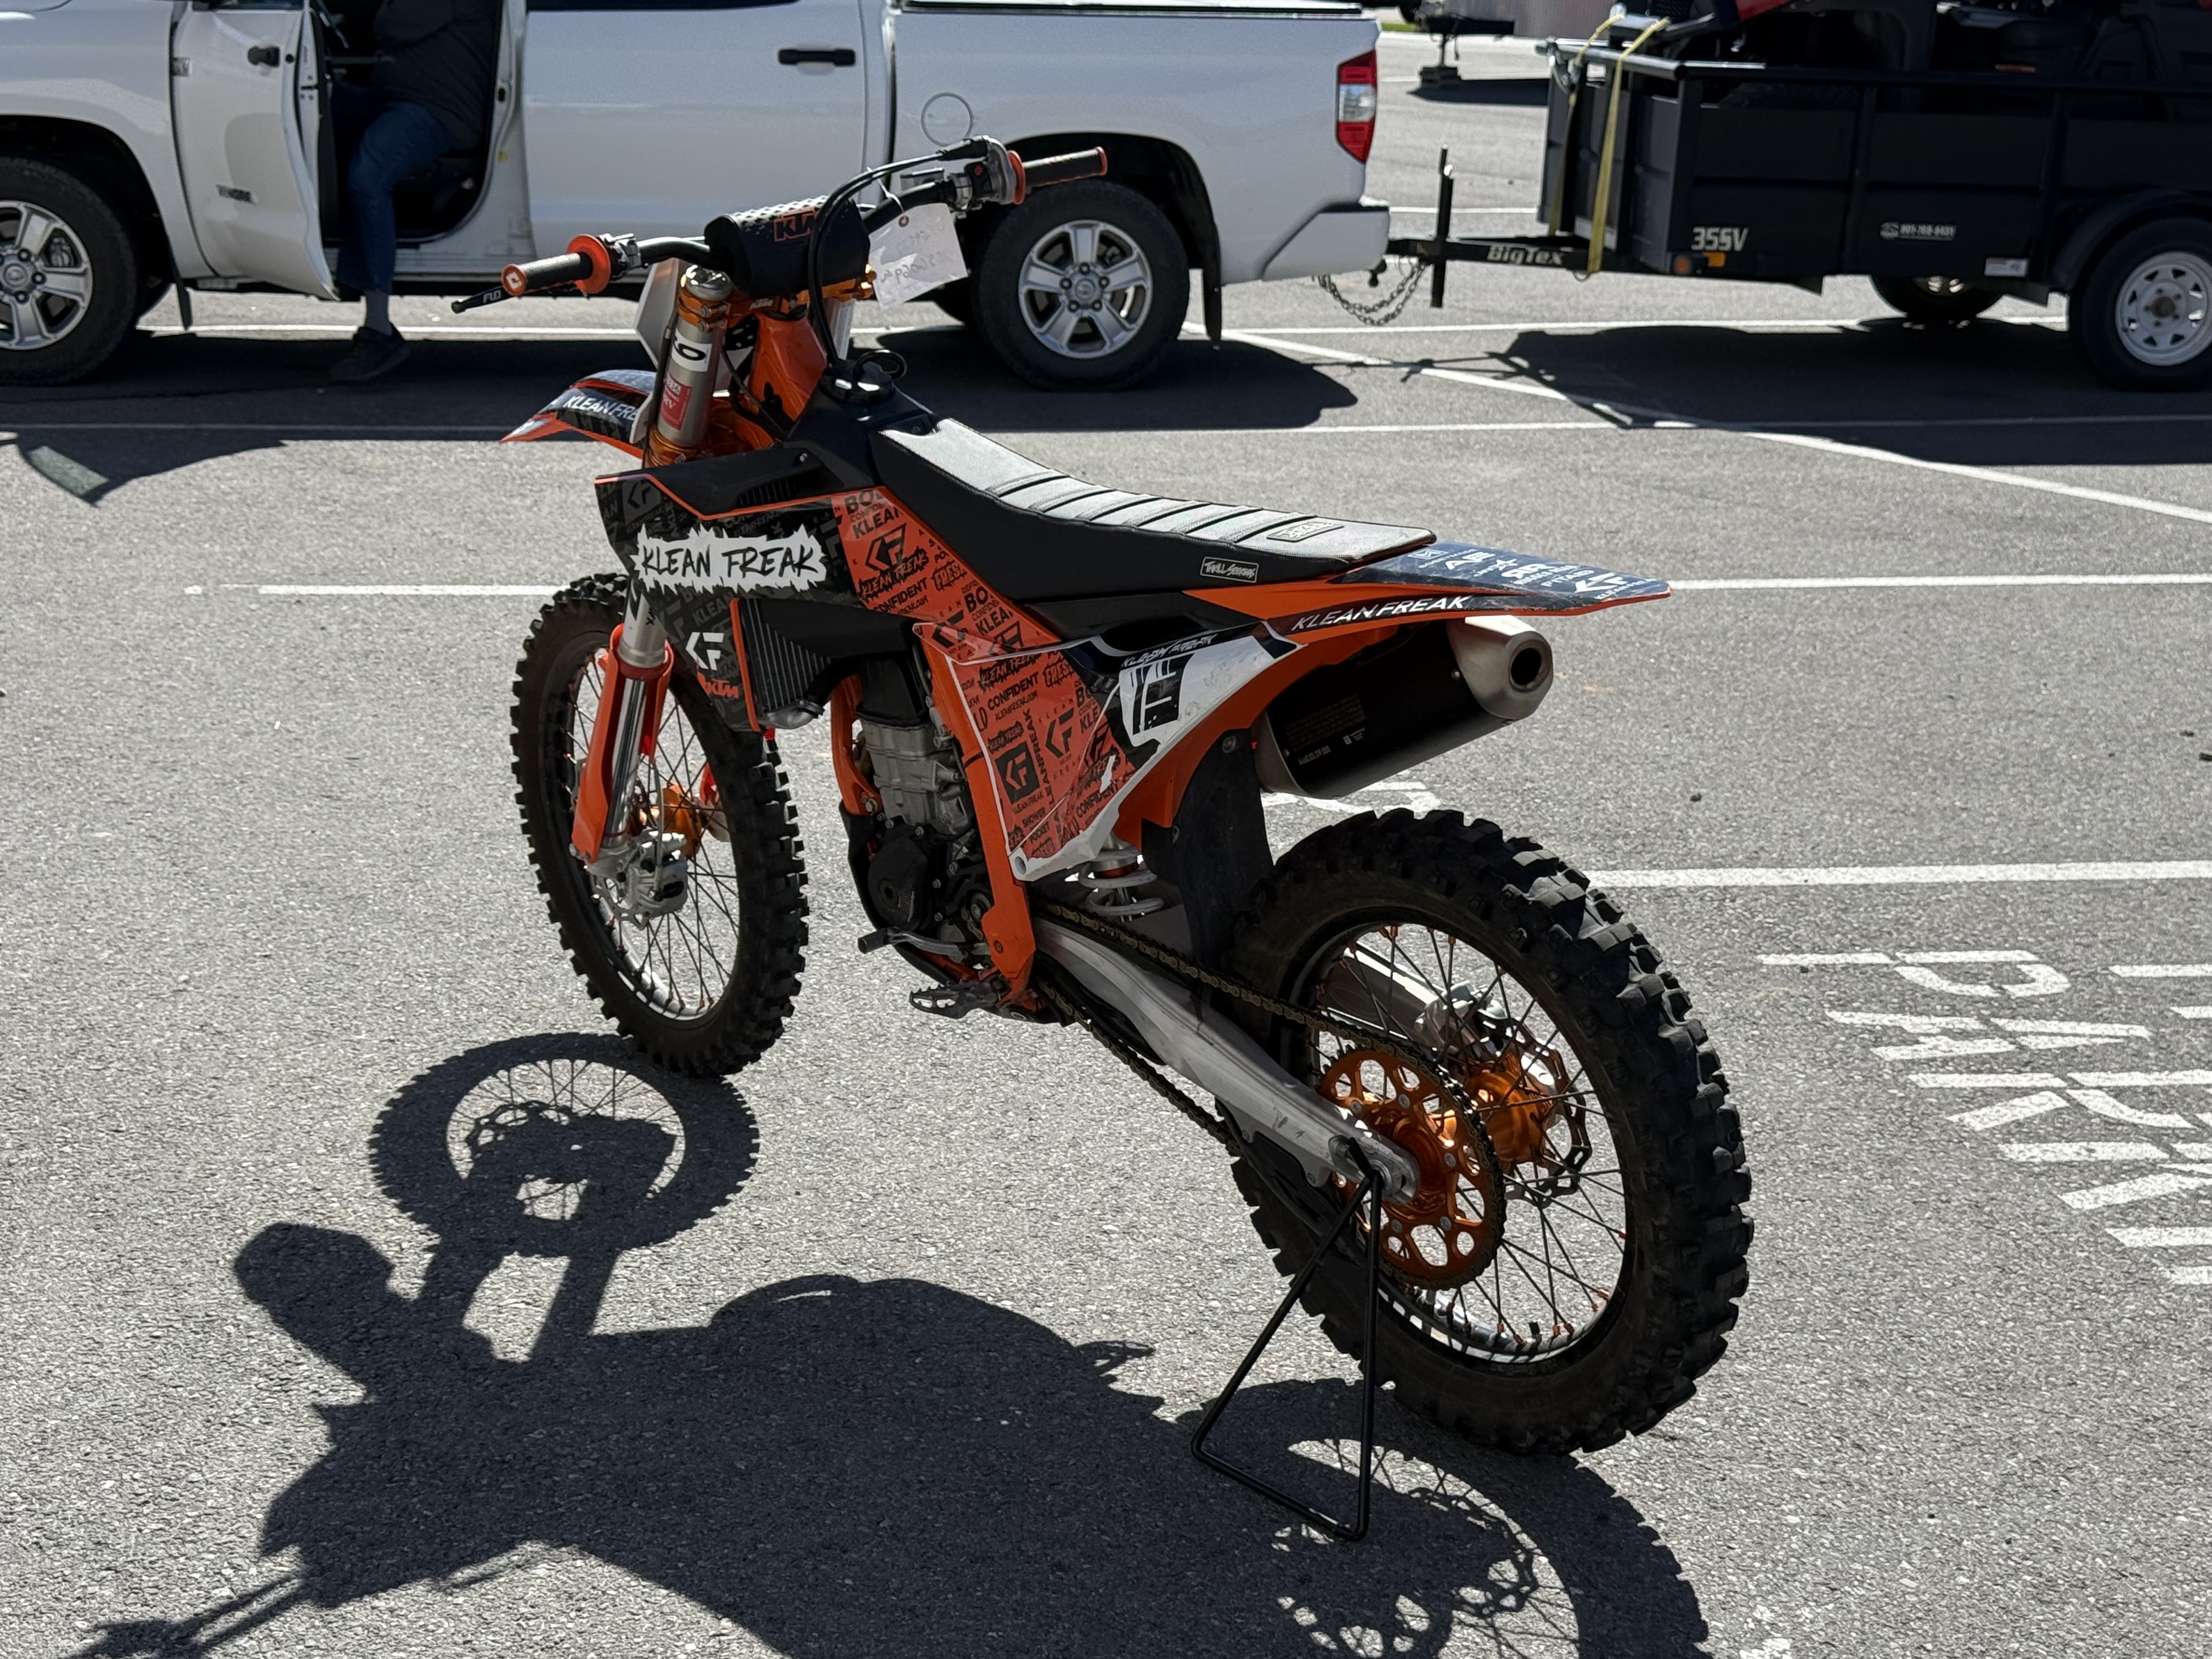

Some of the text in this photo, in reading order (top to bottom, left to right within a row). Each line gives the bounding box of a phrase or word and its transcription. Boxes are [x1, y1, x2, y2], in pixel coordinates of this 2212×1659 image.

[641, 544, 819, 579] KLEAN FREAK
[988, 671, 1039, 710] CONFIDENT
[1022, 807, 1046, 826] SHOWER
[1757, 950, 2212, 1286] PARK
